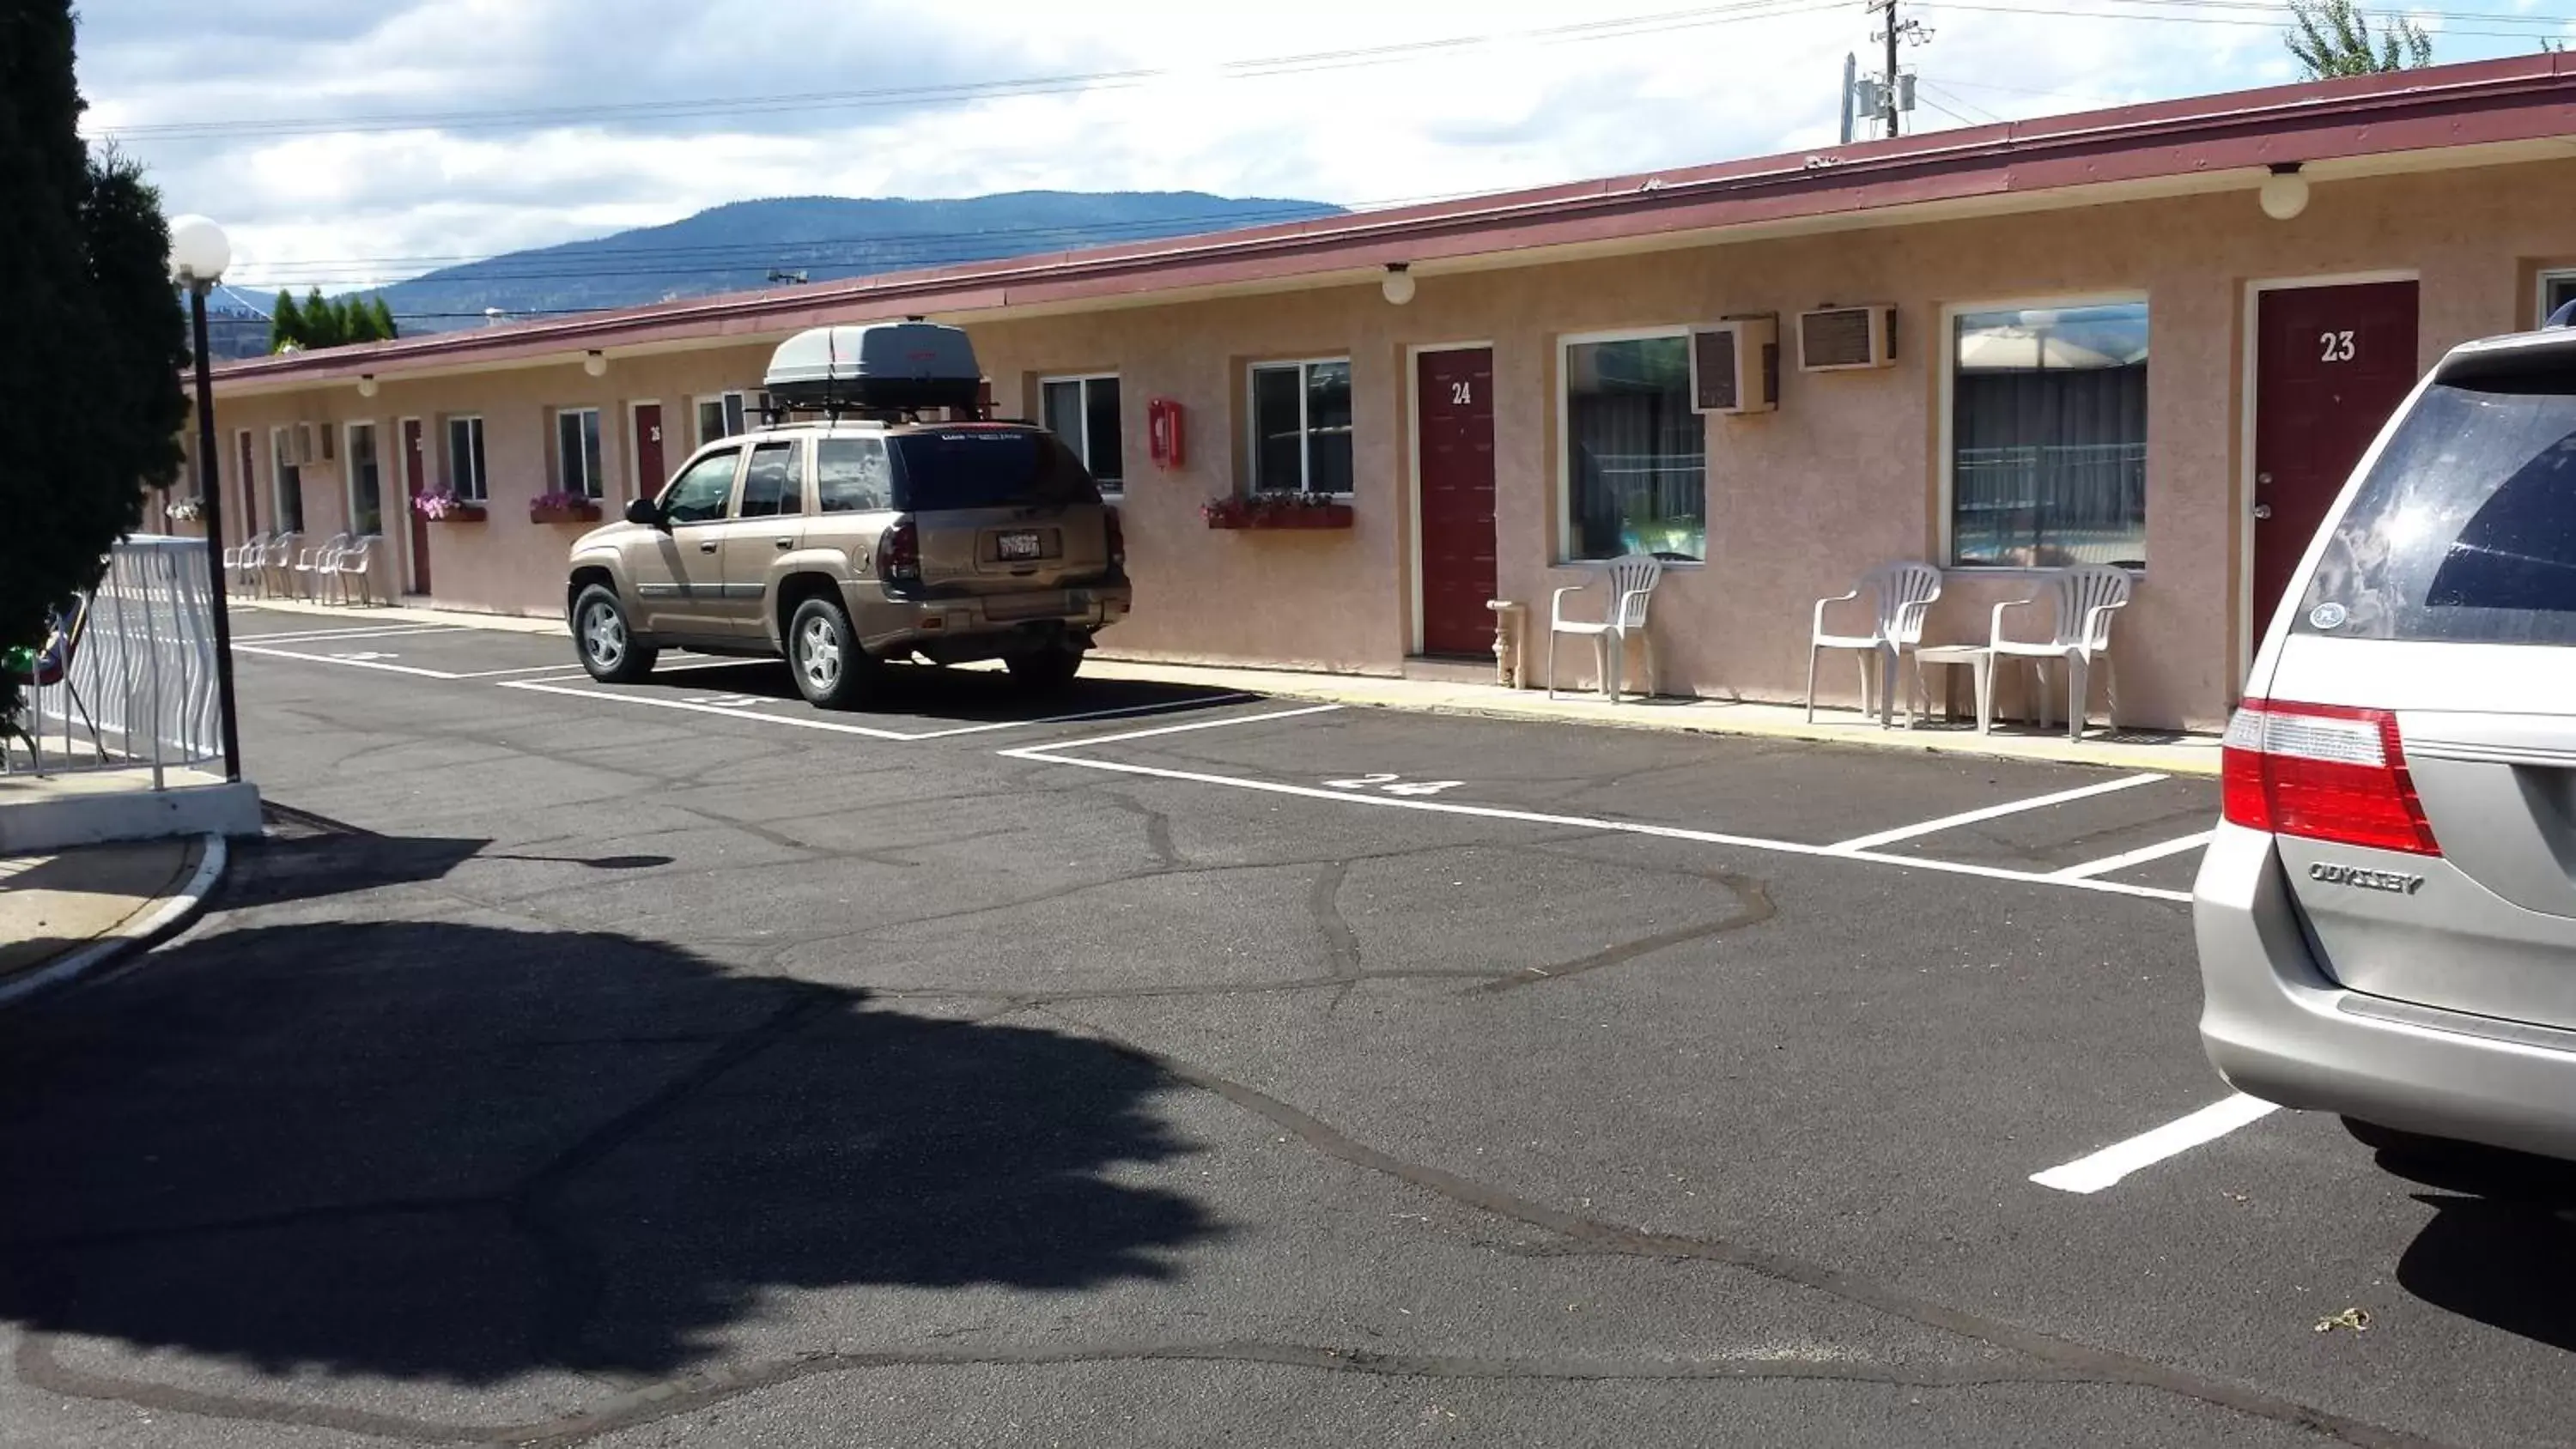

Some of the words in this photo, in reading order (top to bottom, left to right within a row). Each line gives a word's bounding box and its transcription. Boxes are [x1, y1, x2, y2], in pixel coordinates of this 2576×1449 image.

[2320, 330, 2355, 361] 23
[1452, 381, 1471, 404] 24
[1321, 773, 1467, 795] 24
[2308, 862, 2426, 895] ODYSSEY
